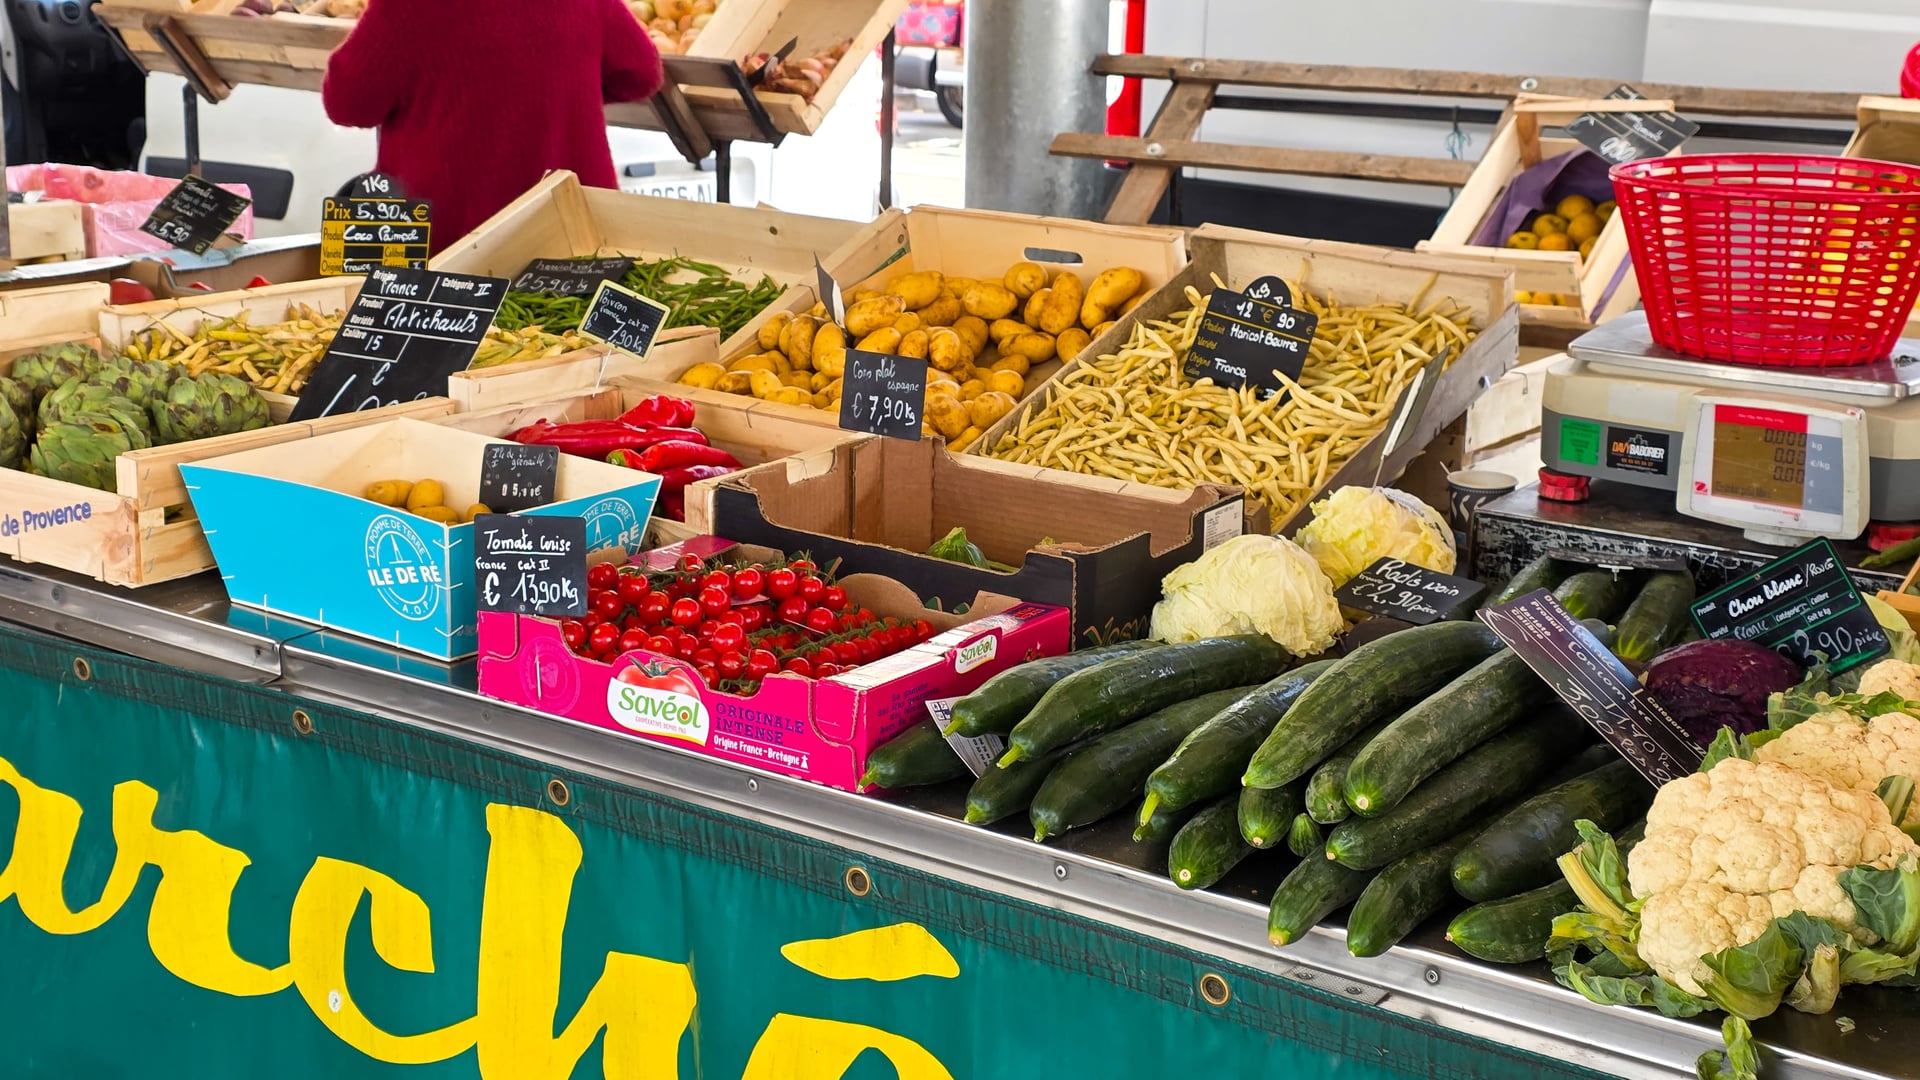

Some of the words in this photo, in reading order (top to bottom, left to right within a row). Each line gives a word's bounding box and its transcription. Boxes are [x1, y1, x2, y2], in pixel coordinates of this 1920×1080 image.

[324, 199, 351, 219] Prix
[413, 204, 429, 221] €
[358, 297, 385, 310] Produit
[350, 314, 375, 326] Variété
[384, 302, 479, 334] Artichauts
[342, 328, 368, 340] Calibre
[1230, 323, 1264, 344] Haricot
[1214, 357, 1247, 378] France
[1811, 441, 1823, 451] kg
[1, 513, 19, 537] de
[22, 502, 92, 533] Provence
[369, 518, 391, 544] POMME
[390, 519, 402, 531] DE
[402, 525, 426, 556] TERRE
[483, 528, 533, 550] Tomate
[368, 569, 395, 587] ILE
[395, 567, 420, 585] DE
[419, 560, 443, 583] RÉ
[1376, 560, 1422, 587] Radis
[482, 571, 501, 607] €
[1696, 602, 1717, 617] Produit
[1727, 595, 1764, 618] Chou
[1762, 573, 1804, 601] blanc
[1809, 591, 1830, 606] Calibre
[1510, 608, 1544, 640] Calibre
[1530, 601, 1565, 633] Produit
[1543, 594, 1577, 627] Origine
[960, 636, 993, 664] Savéol
[618, 687, 702, 729] Savéol
[715, 702, 805, 734] ORIGINALE
[1646, 696, 1691, 738] Catégorie
[713, 734, 739, 750] Origine
[715, 717, 784, 744] INTENSE
